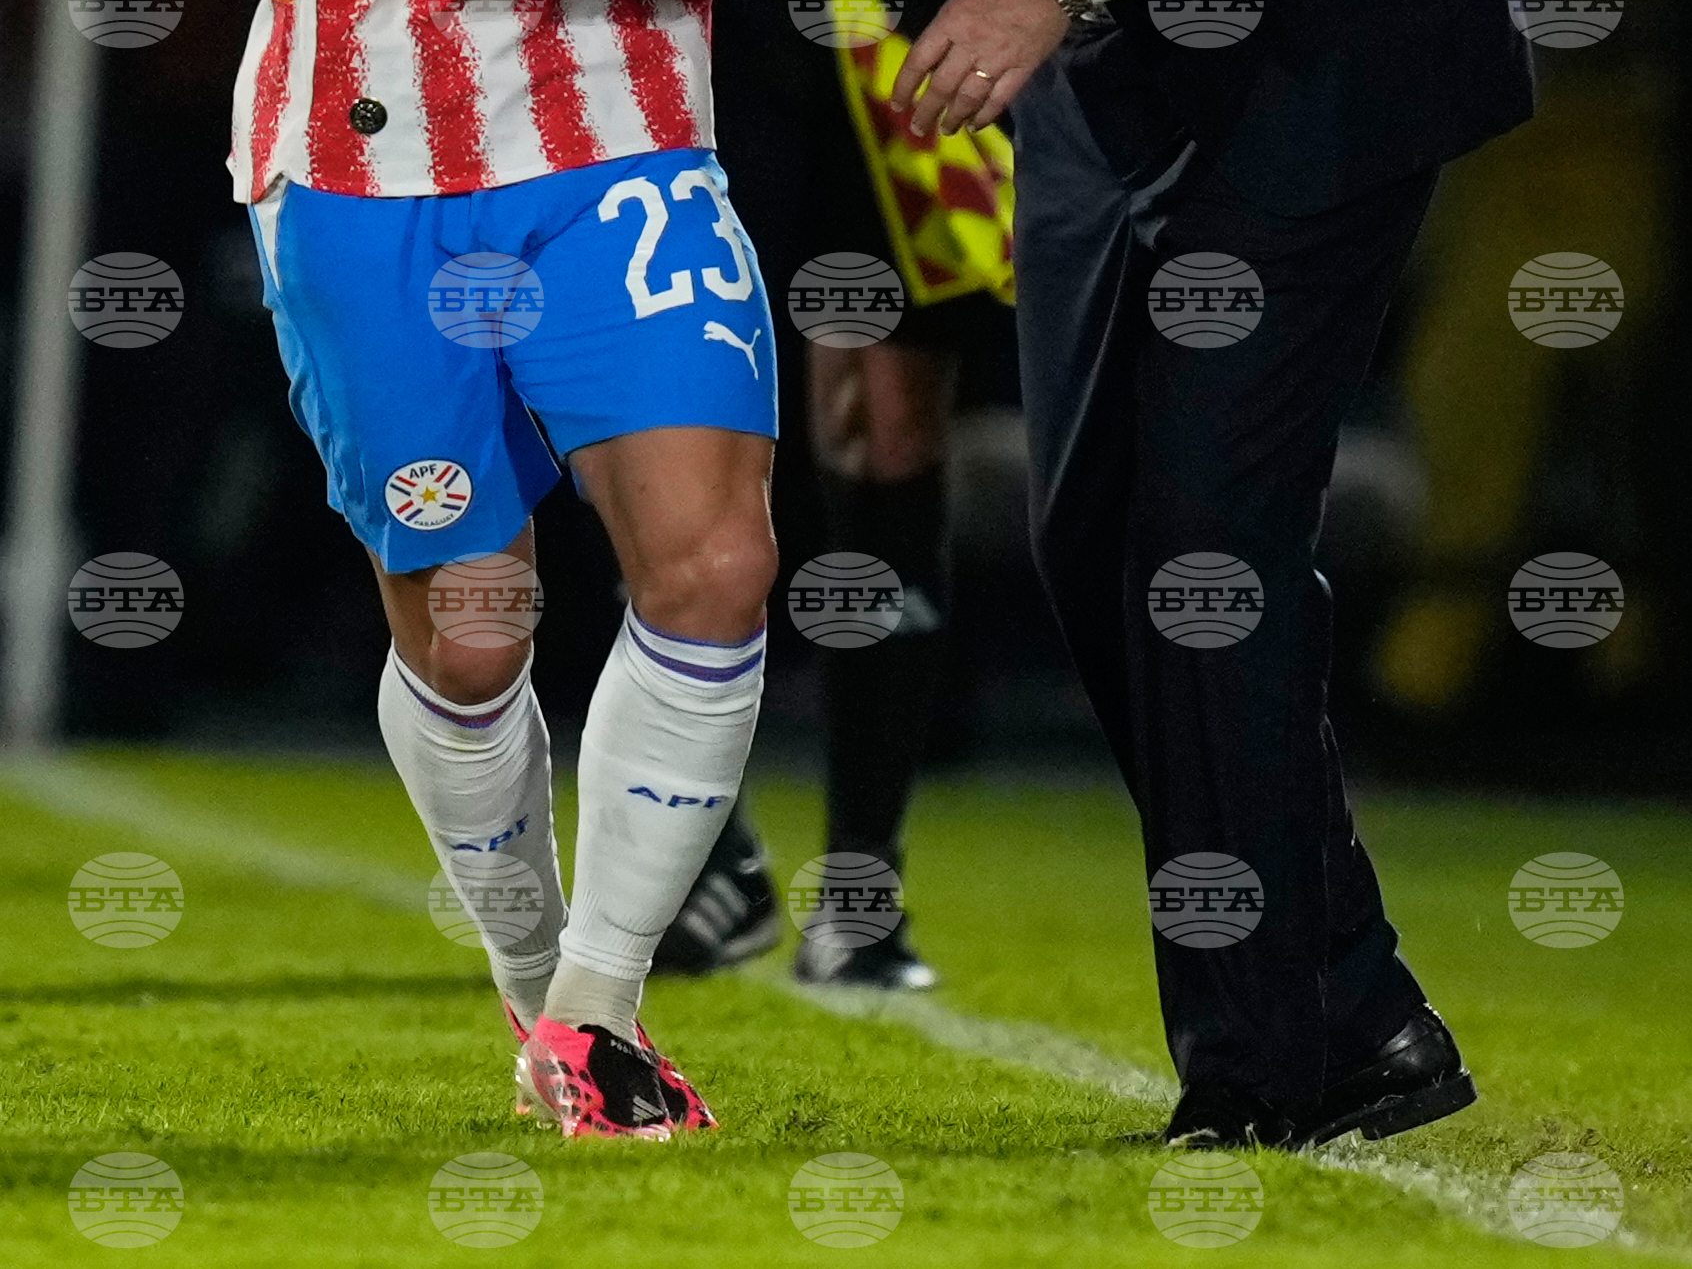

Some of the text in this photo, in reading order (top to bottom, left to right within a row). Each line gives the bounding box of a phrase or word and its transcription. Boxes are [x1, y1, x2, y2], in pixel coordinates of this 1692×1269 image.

[597, 169, 753, 320] 23
[409, 463, 438, 480] APF
[413, 513, 455, 528] PARAGUAY
[627, 785, 730, 808] APF
[452, 813, 529, 852] APF
